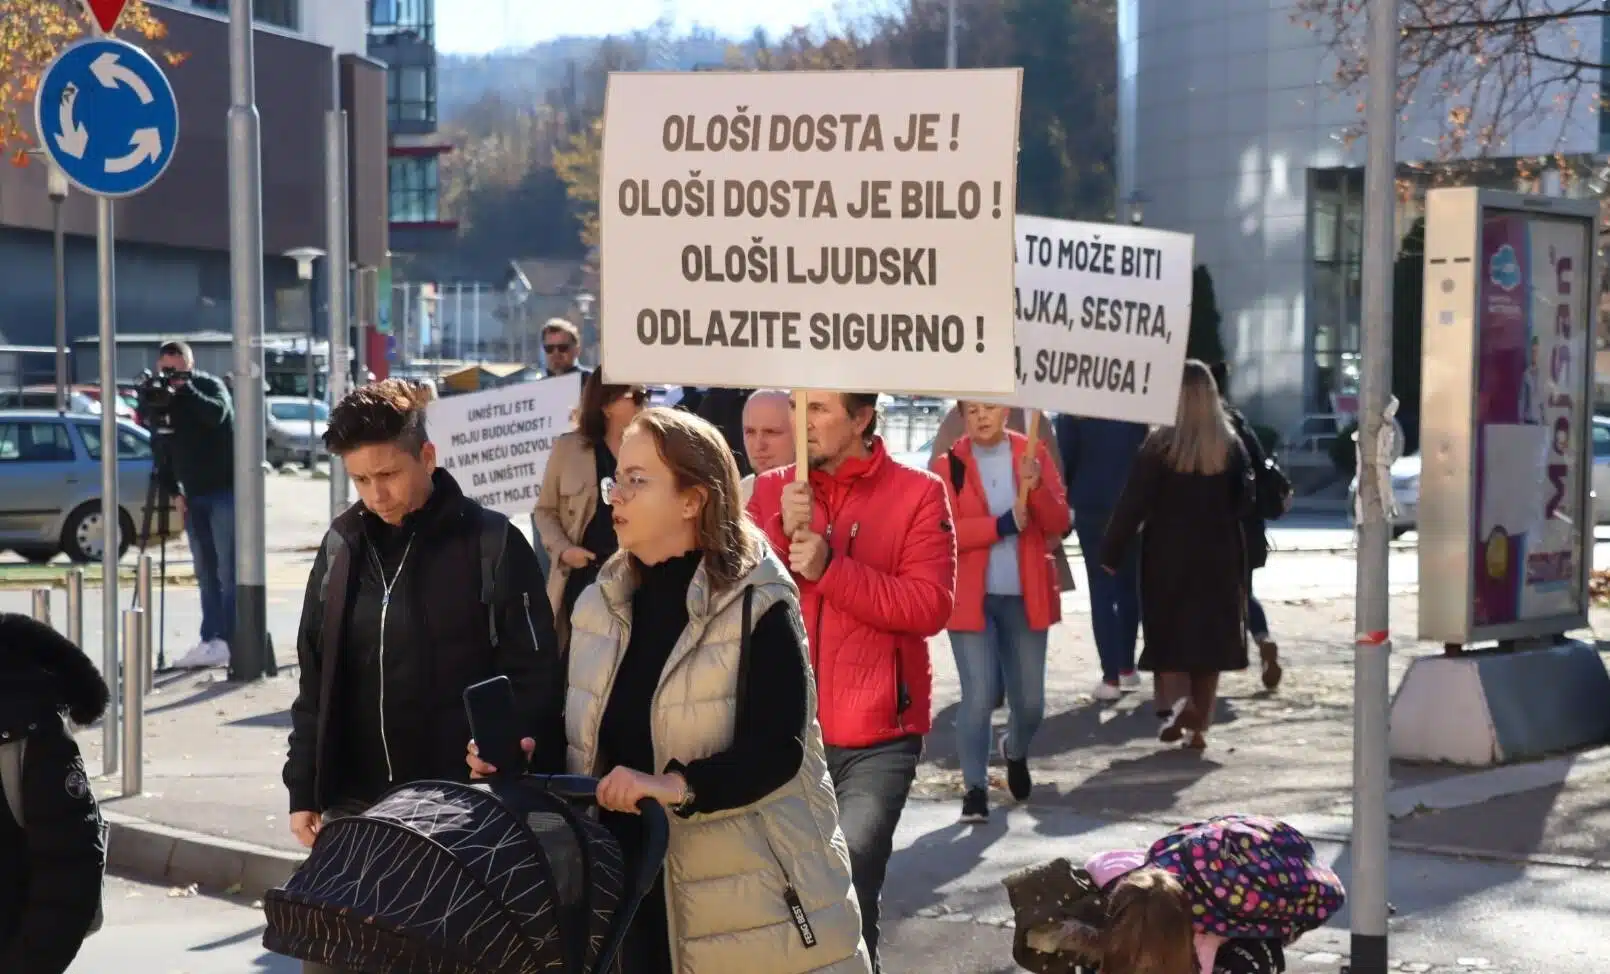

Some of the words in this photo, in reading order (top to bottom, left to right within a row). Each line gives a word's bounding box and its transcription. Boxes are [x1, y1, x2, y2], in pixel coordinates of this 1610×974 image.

[663, 106, 762, 151] OLOŠI
[769, 114, 884, 151] DOSTA
[894, 114, 940, 151] JE
[950, 113, 960, 151] !
[618, 170, 714, 217] OLOŠI
[724, 180, 837, 218] DOSTA
[847, 181, 892, 218] JE
[902, 181, 980, 219] BILO
[992, 181, 1002, 219] !
[682, 237, 777, 283] OLOŠI
[787, 247, 937, 285] LJUDSKI
[1026, 235, 1052, 266] TO
[1058, 234, 1115, 274] MOŽE
[1121, 246, 1162, 280] BITI
[636, 308, 801, 348] ODLAZITE
[809, 312, 964, 353] SIGURNO
[975, 316, 985, 353] !
[1081, 296, 1172, 344] SESTRA,
[1034, 349, 1136, 394] SUPRUGA
[1142, 362, 1151, 394] !
[452, 431, 480, 446] MOJU
[482, 417, 545, 440] BUDUĆNOST
[468, 404, 512, 422] UNIŠTILI
[515, 399, 535, 412] STE
[444, 457, 455, 469] JA
[458, 453, 479, 467] VAM
[481, 446, 508, 463] NEĆU
[510, 436, 552, 456] DOZVOL
[473, 474, 488, 486] DA
[490, 463, 535, 483] UNIŠTITE
[504, 487, 531, 502] MOJE
